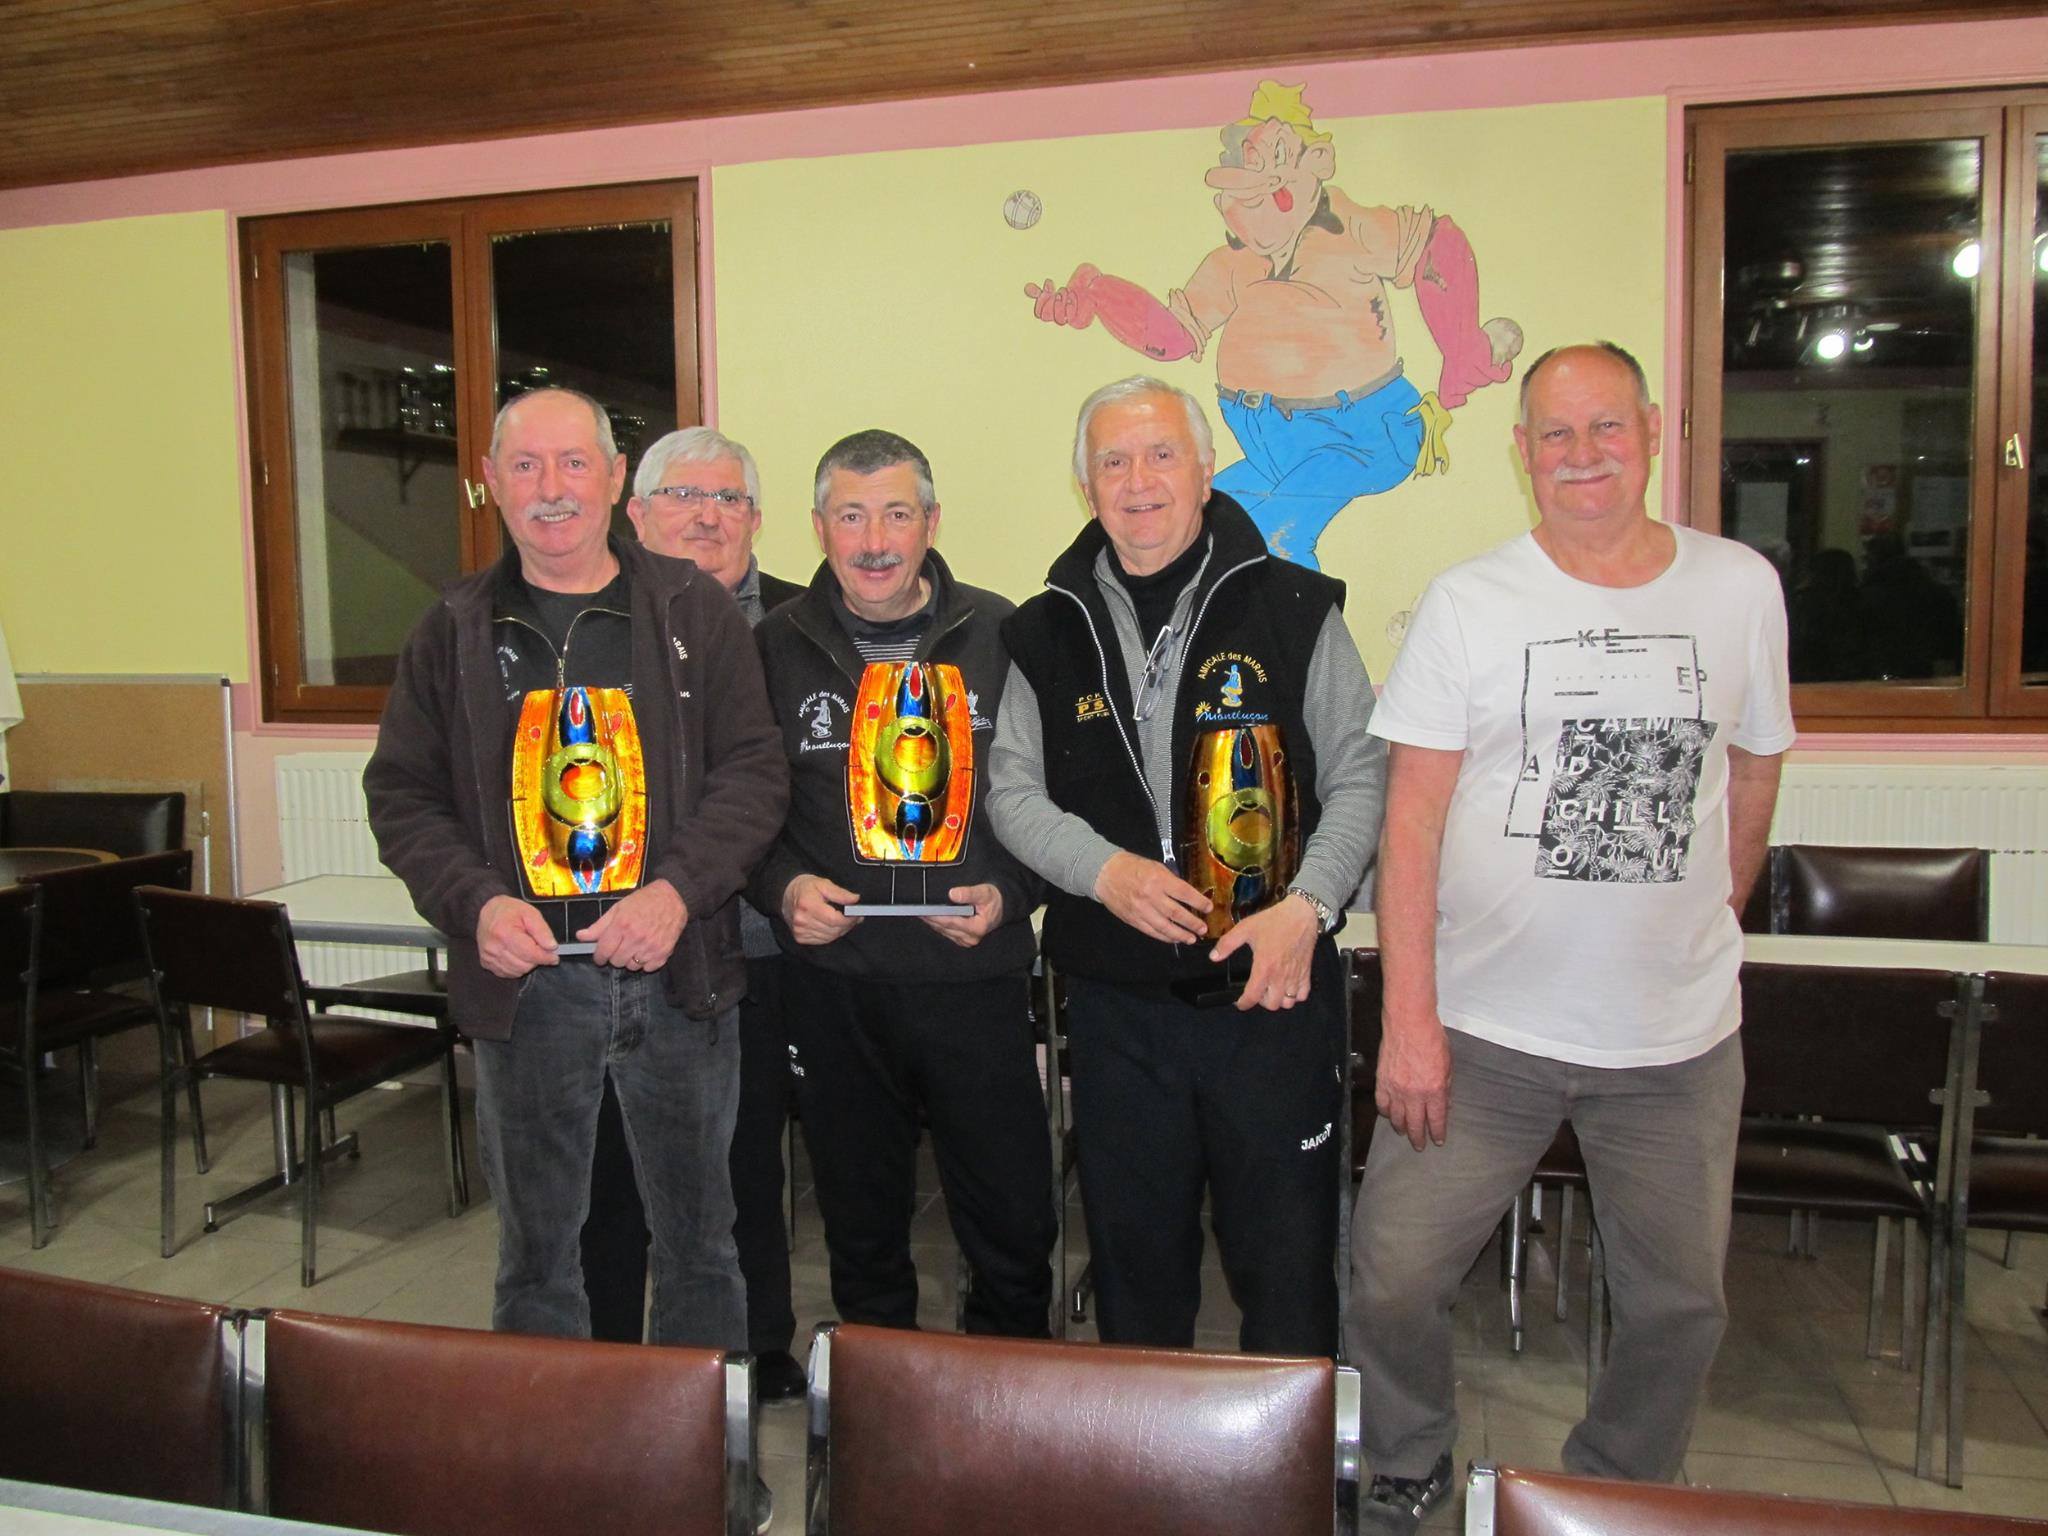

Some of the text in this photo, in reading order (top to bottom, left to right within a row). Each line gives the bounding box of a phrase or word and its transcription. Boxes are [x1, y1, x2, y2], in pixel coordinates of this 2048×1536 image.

[1197, 652, 1268, 683] AMICALE des MARAIS
[1559, 799, 1671, 823] CHILL
[1301, 1130, 1328, 1151] JAKO
